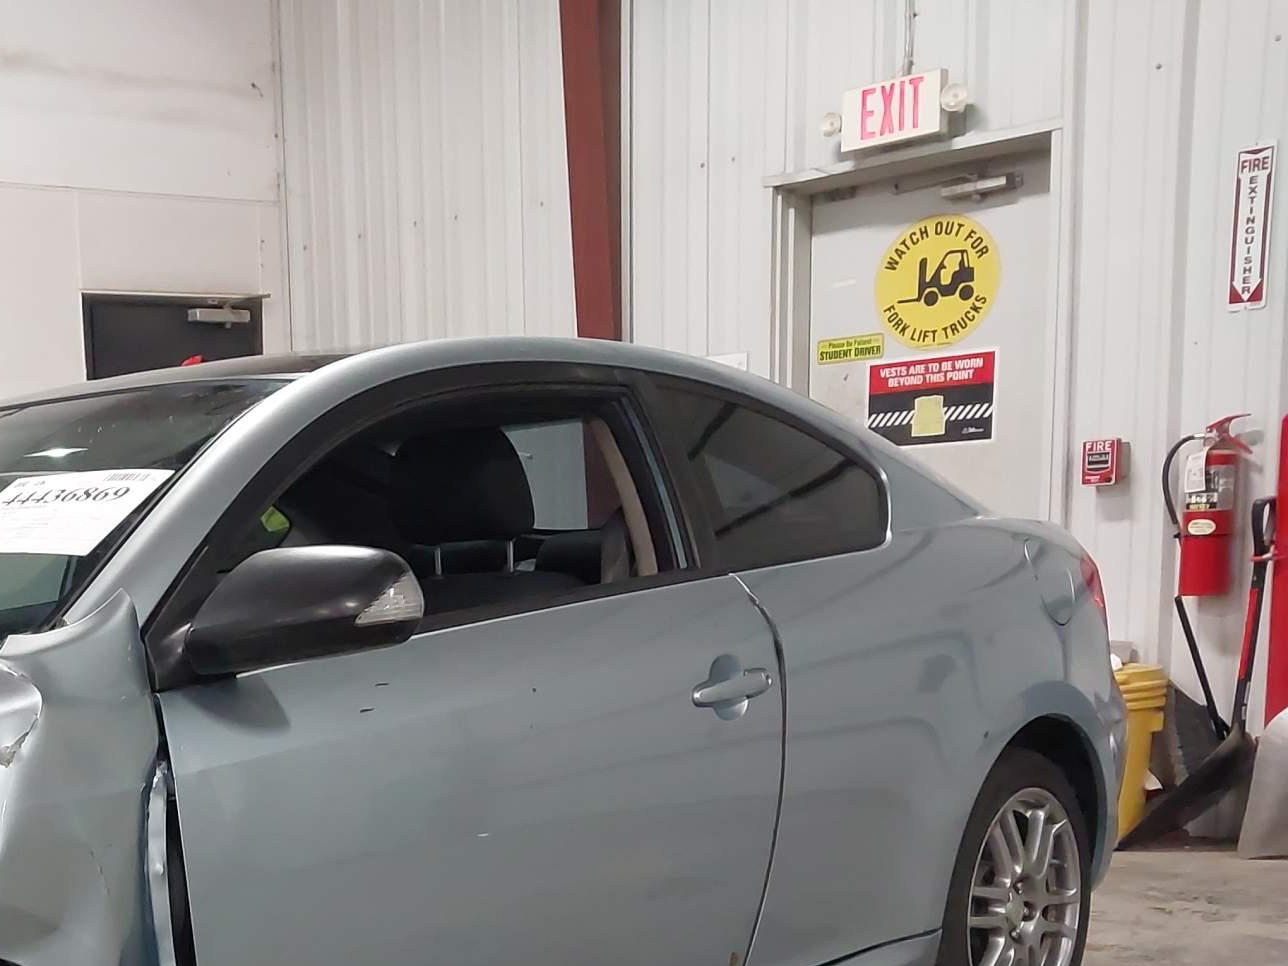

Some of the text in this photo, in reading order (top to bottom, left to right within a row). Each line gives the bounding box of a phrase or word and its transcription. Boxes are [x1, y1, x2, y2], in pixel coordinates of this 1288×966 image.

[860, 76, 924, 140] EXIT
[1240, 156, 1270, 174] FIRE
[1241, 175, 1259, 295] EXTINGUISHER
[884, 220, 990, 272] WATCH OUT FOR
[883, 294, 988, 343] FORK LIFT TRUCKS
[819, 345, 881, 361] STUDENT DRIVER
[880, 357, 984, 378] VESTS ARE TO BE WORN
[887, 369, 975, 388] BEYOND THIS POINT
[1085, 440, 1113, 452] FIRE
[2, 486, 131, 506] 44436869
